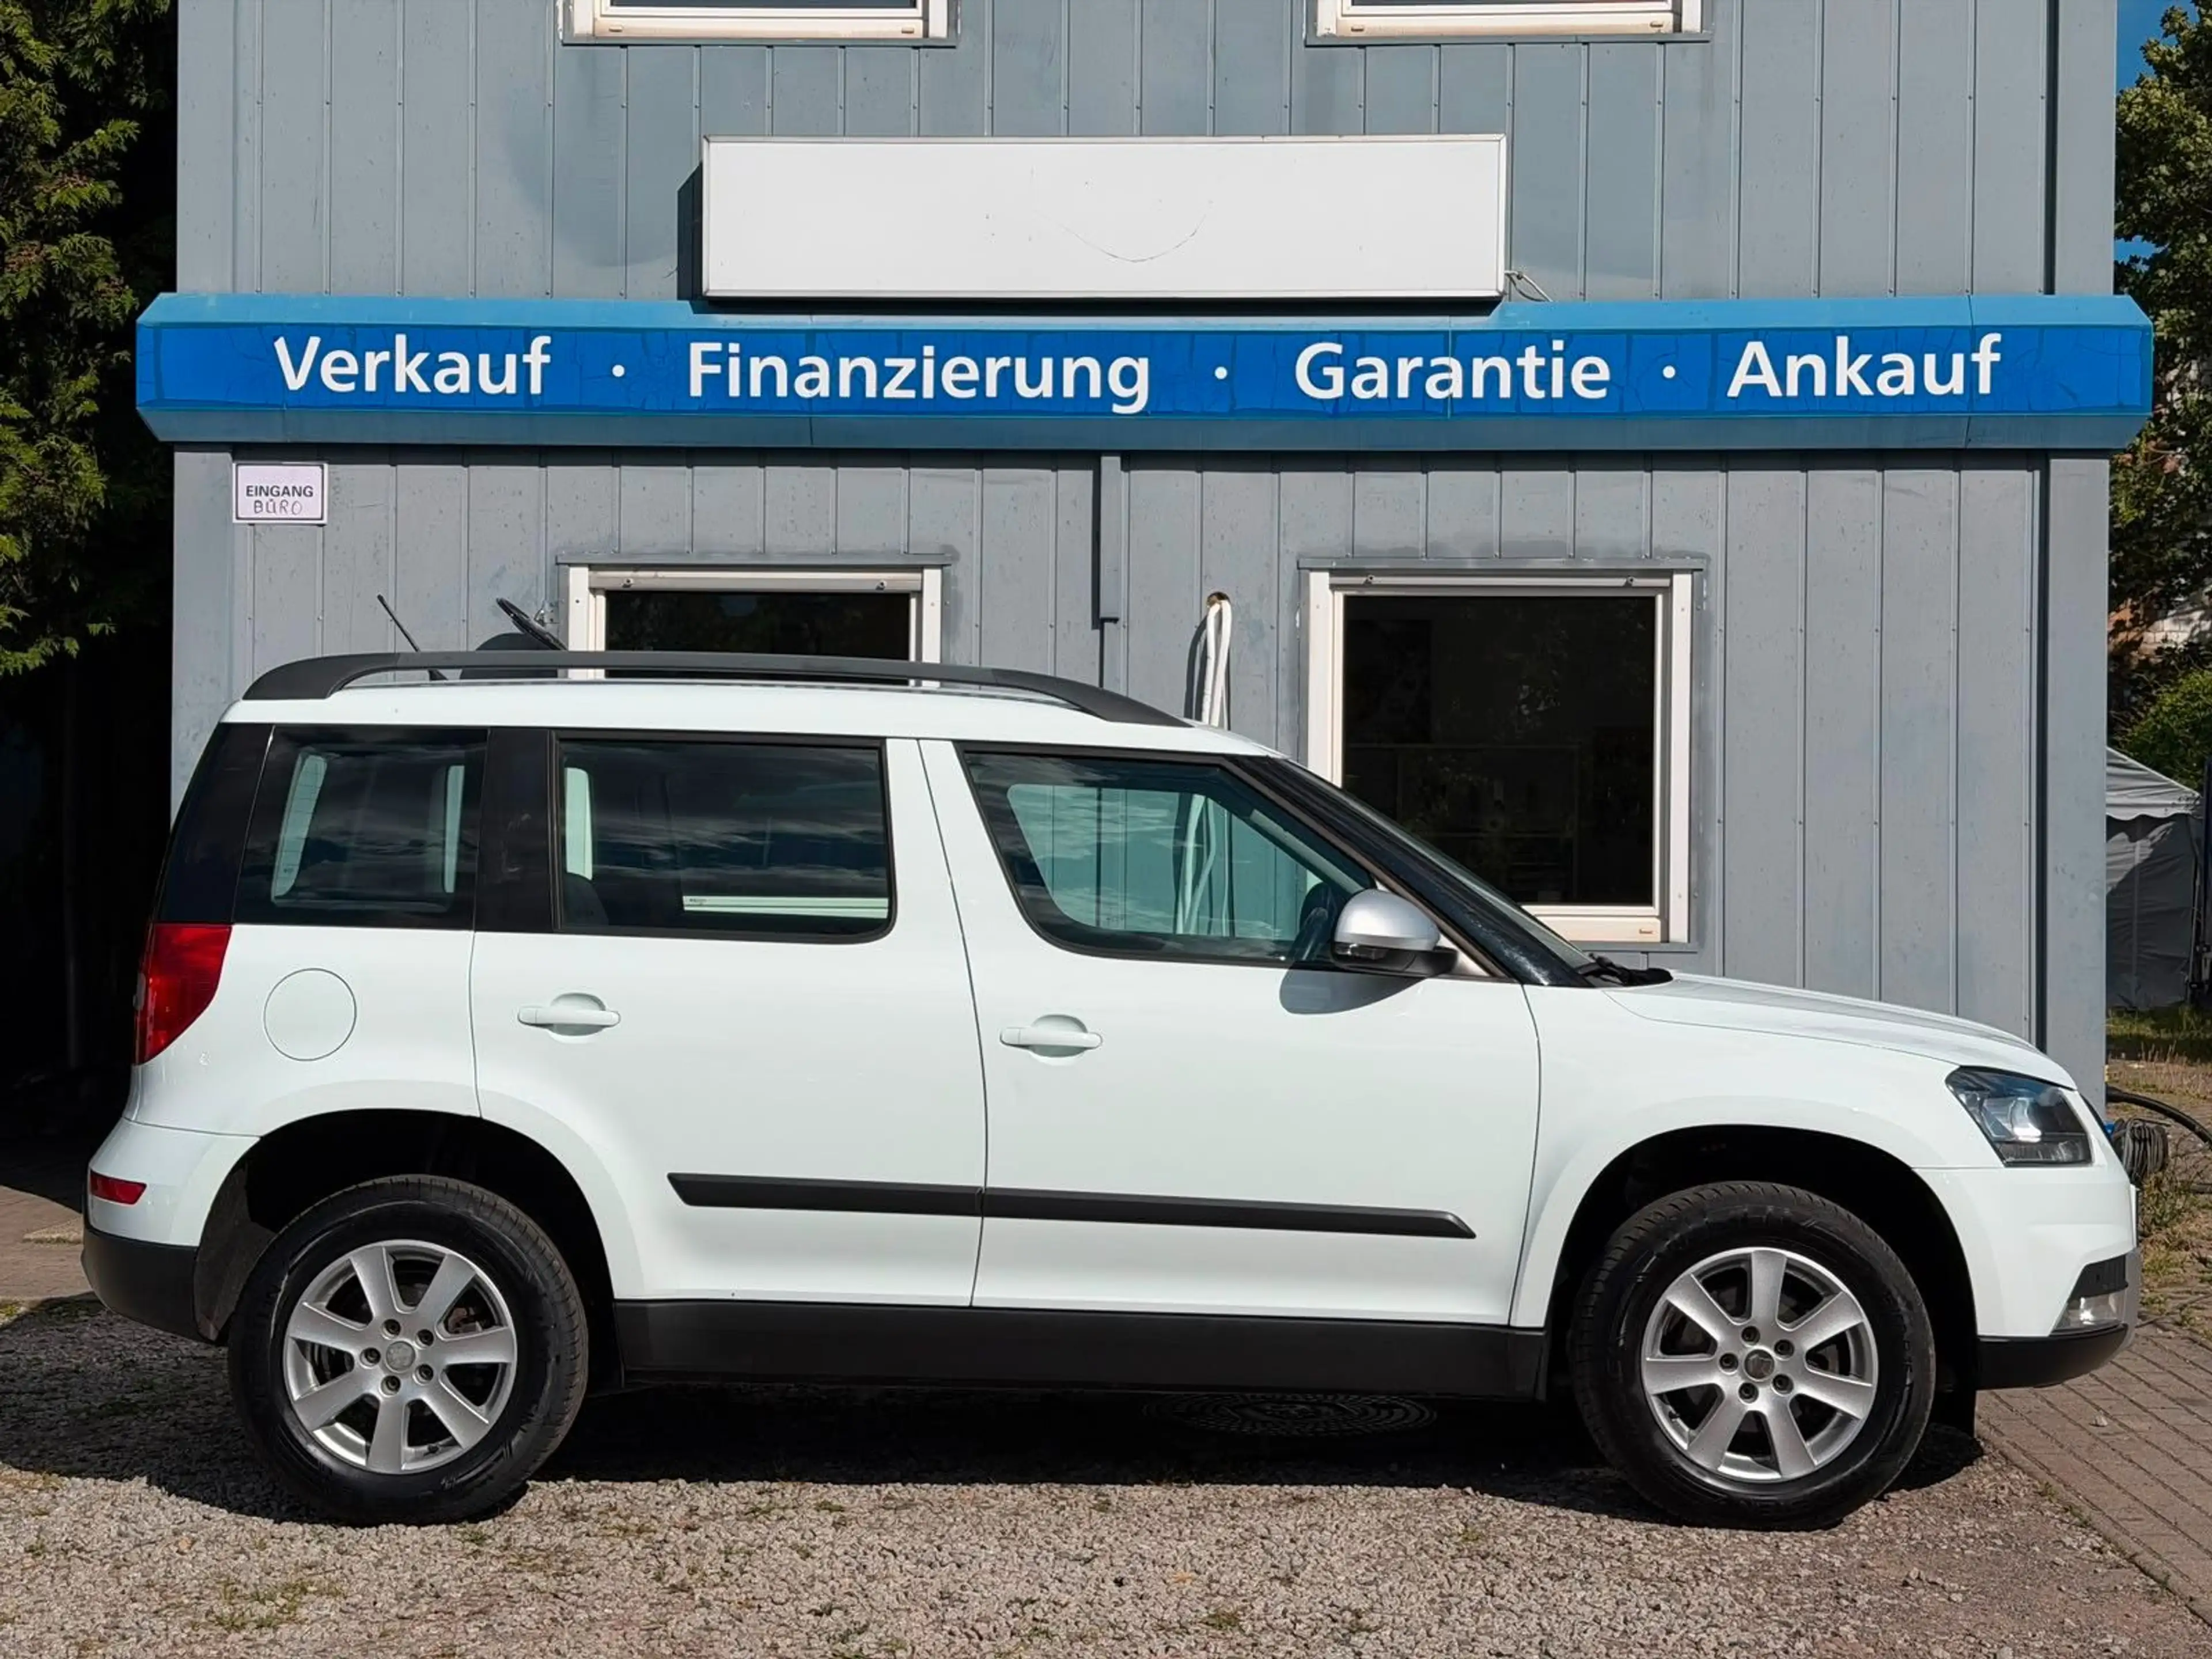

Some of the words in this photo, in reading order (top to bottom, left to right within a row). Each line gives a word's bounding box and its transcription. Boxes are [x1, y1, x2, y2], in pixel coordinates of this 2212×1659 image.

[274, 334, 551, 395] Verkauf
[690, 342, 1149, 414] Finanzierung
[1295, 340, 1610, 399] Garantie
[1726, 332, 2002, 397] Ankauf
[246, 485, 313, 497] EINGANG
[254, 498, 303, 515] BÜRO
